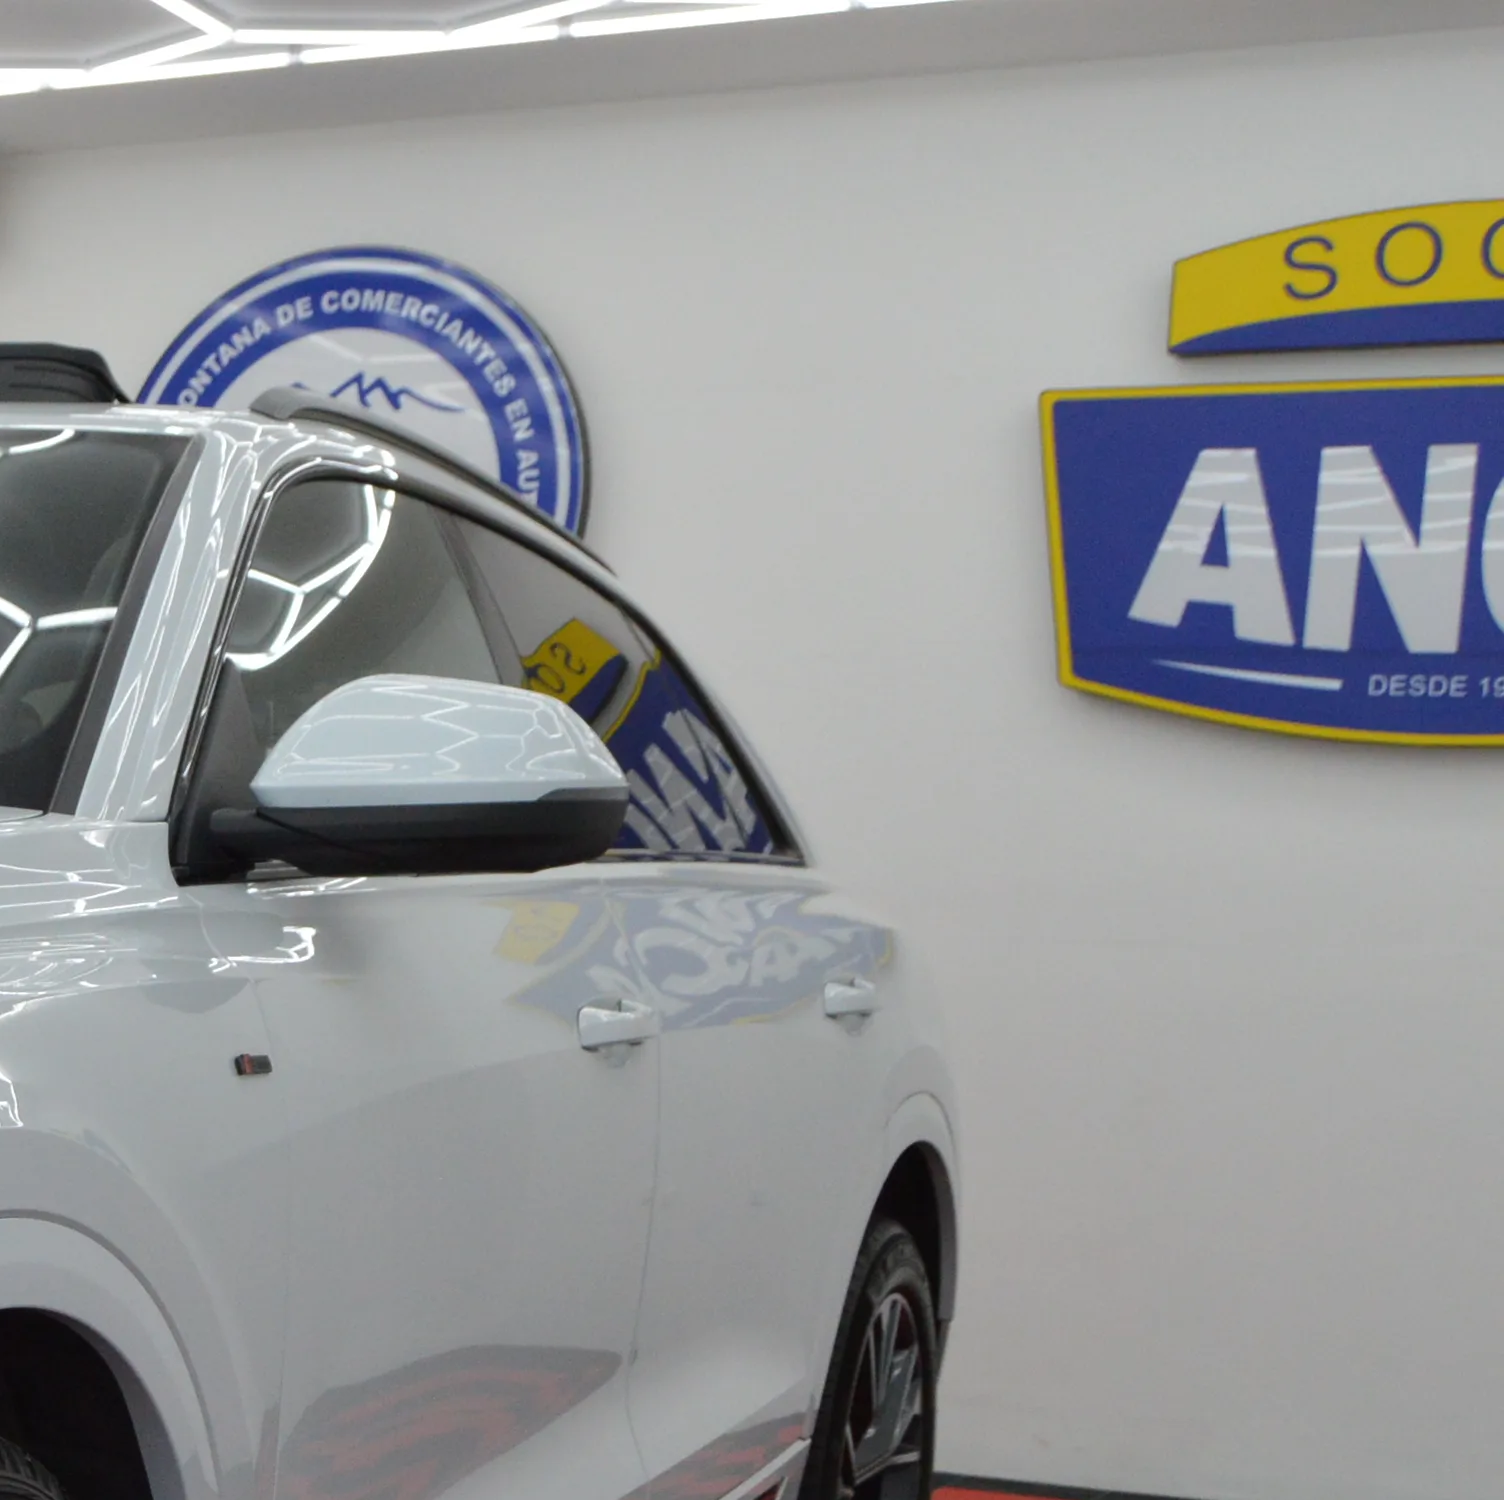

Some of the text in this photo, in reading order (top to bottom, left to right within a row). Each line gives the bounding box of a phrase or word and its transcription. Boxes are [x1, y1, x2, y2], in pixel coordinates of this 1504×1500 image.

[276, 296, 314, 327] DE
[320, 288, 516, 398] COMERCIANTES
[504, 398, 535, 442] EN
[1367, 674, 1469, 698] DESDE
